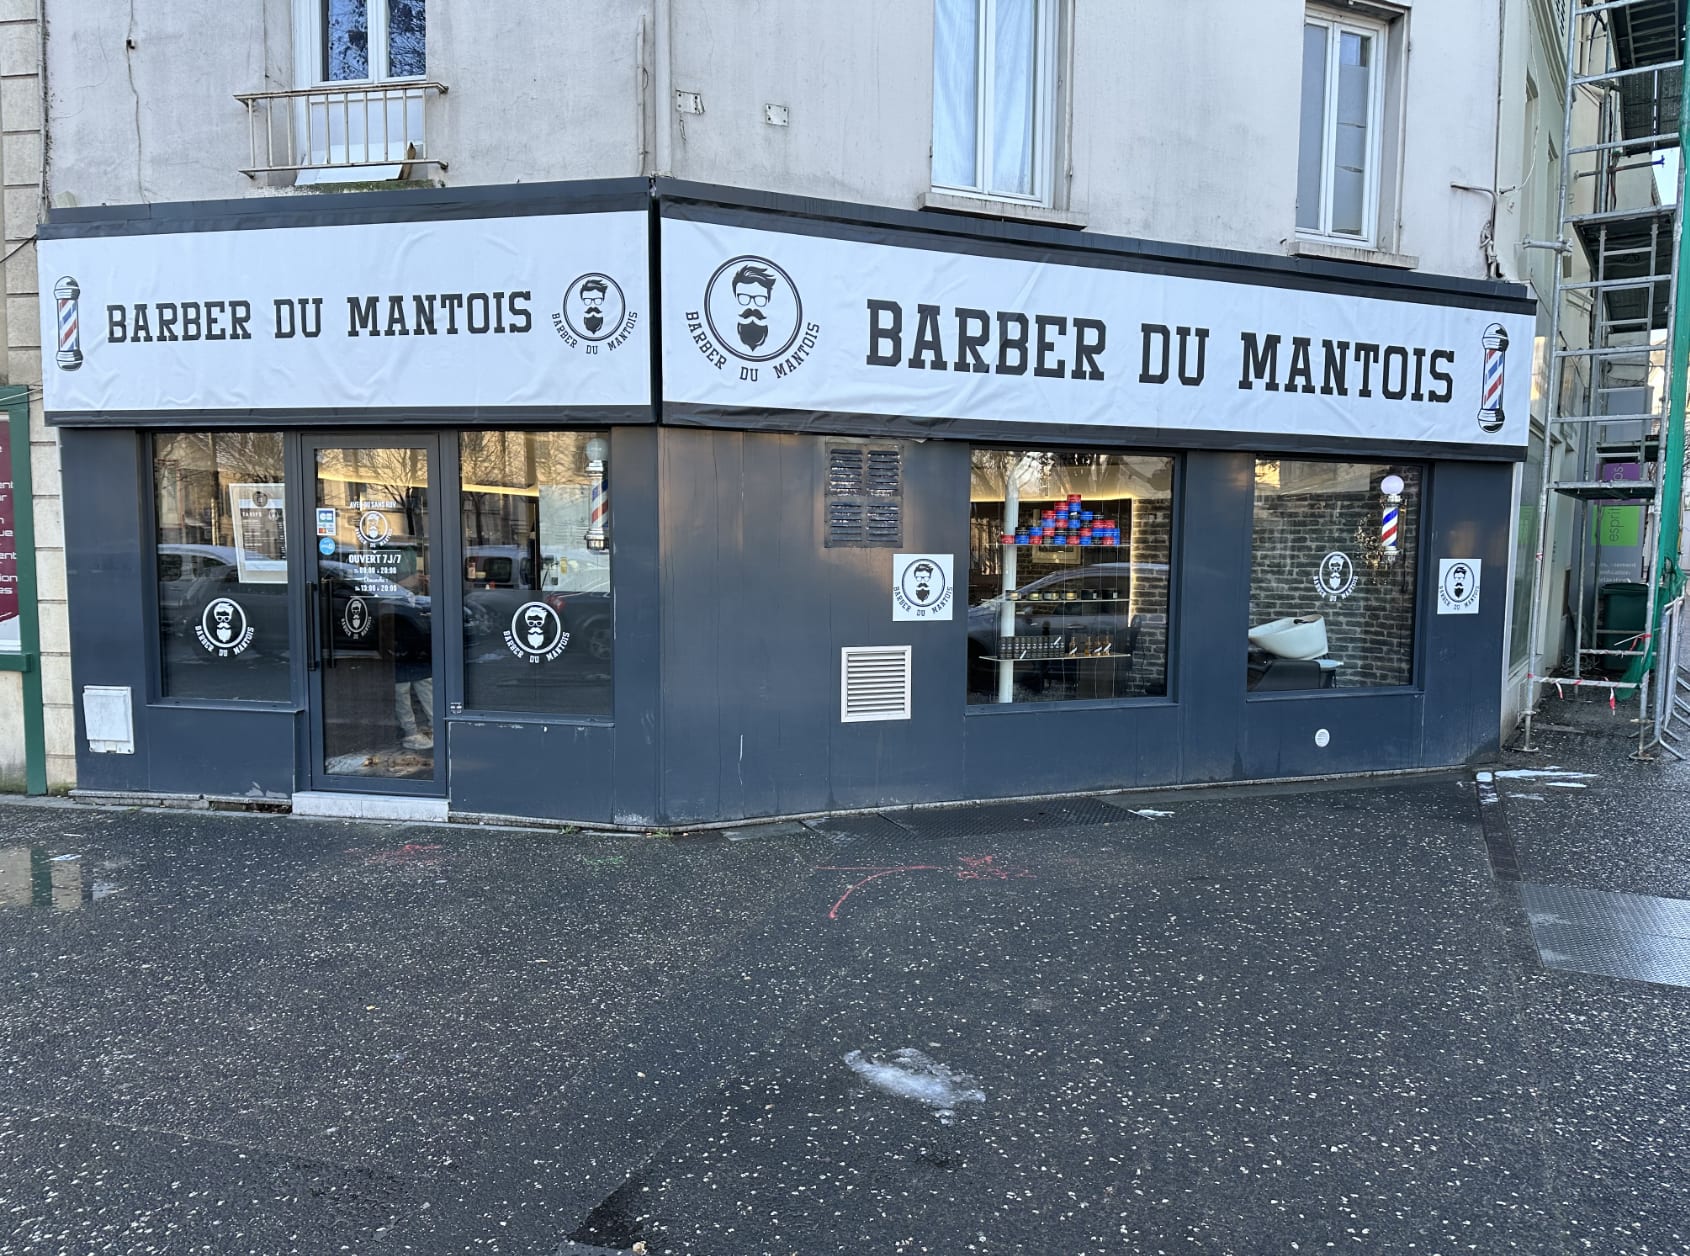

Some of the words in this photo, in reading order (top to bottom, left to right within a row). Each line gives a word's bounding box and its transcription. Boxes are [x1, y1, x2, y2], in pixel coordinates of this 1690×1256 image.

[106, 300, 252, 344] BARBER
[273, 297, 323, 339] DU
[346, 290, 532, 337] MANTOIS
[552, 312, 578, 349] BARBER
[586, 344, 598, 355] DU
[607, 311, 638, 352] MANTOIS
[685, 311, 727, 370] BARBER
[739, 366, 759, 382] DU
[772, 321, 820, 379] MANTOIS
[866, 298, 1107, 381] BARBER
[1138, 322, 1210, 387] DU
[1238, 331, 1455, 404] MANTOIS
[348, 554, 381, 564] OUVERT
[382, 554, 402, 564] 7J/7
[503, 630, 524, 659] BARBER
[529, 655, 540, 664] DU
[545, 631, 570, 662] MANTOIS
